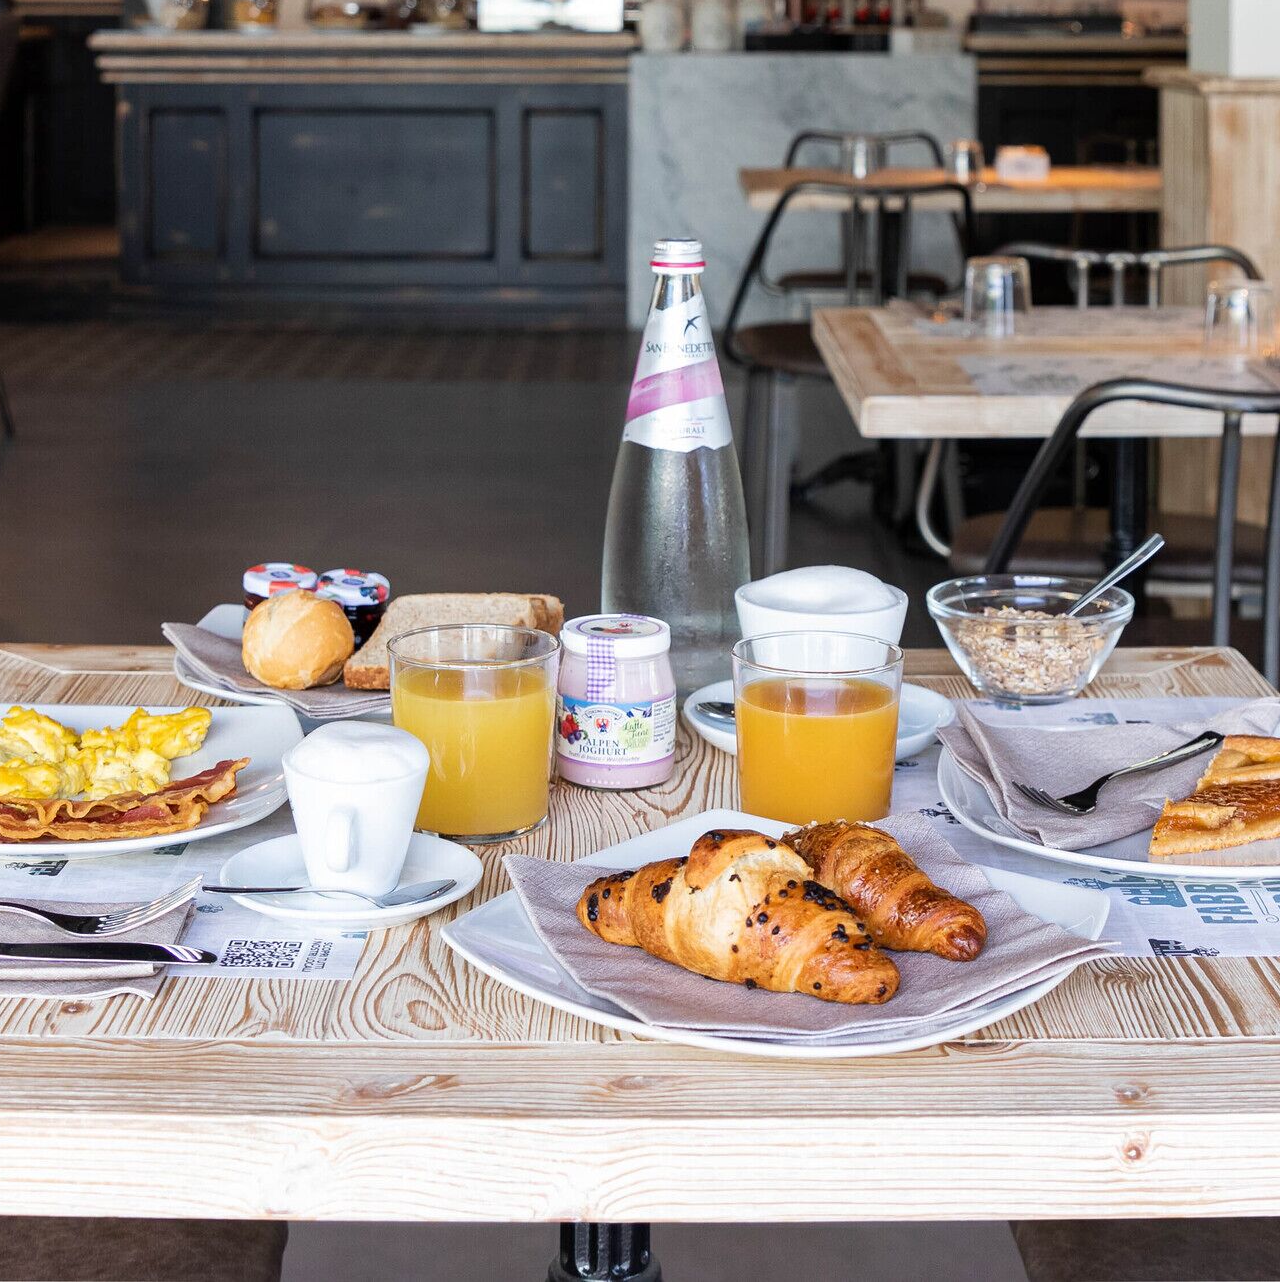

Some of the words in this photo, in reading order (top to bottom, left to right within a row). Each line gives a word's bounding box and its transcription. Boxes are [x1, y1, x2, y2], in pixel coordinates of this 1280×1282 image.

[586, 738, 620, 747] ALPEN
[579, 744, 628, 756] JOGHURT
[1185, 880, 1259, 924] FABB
